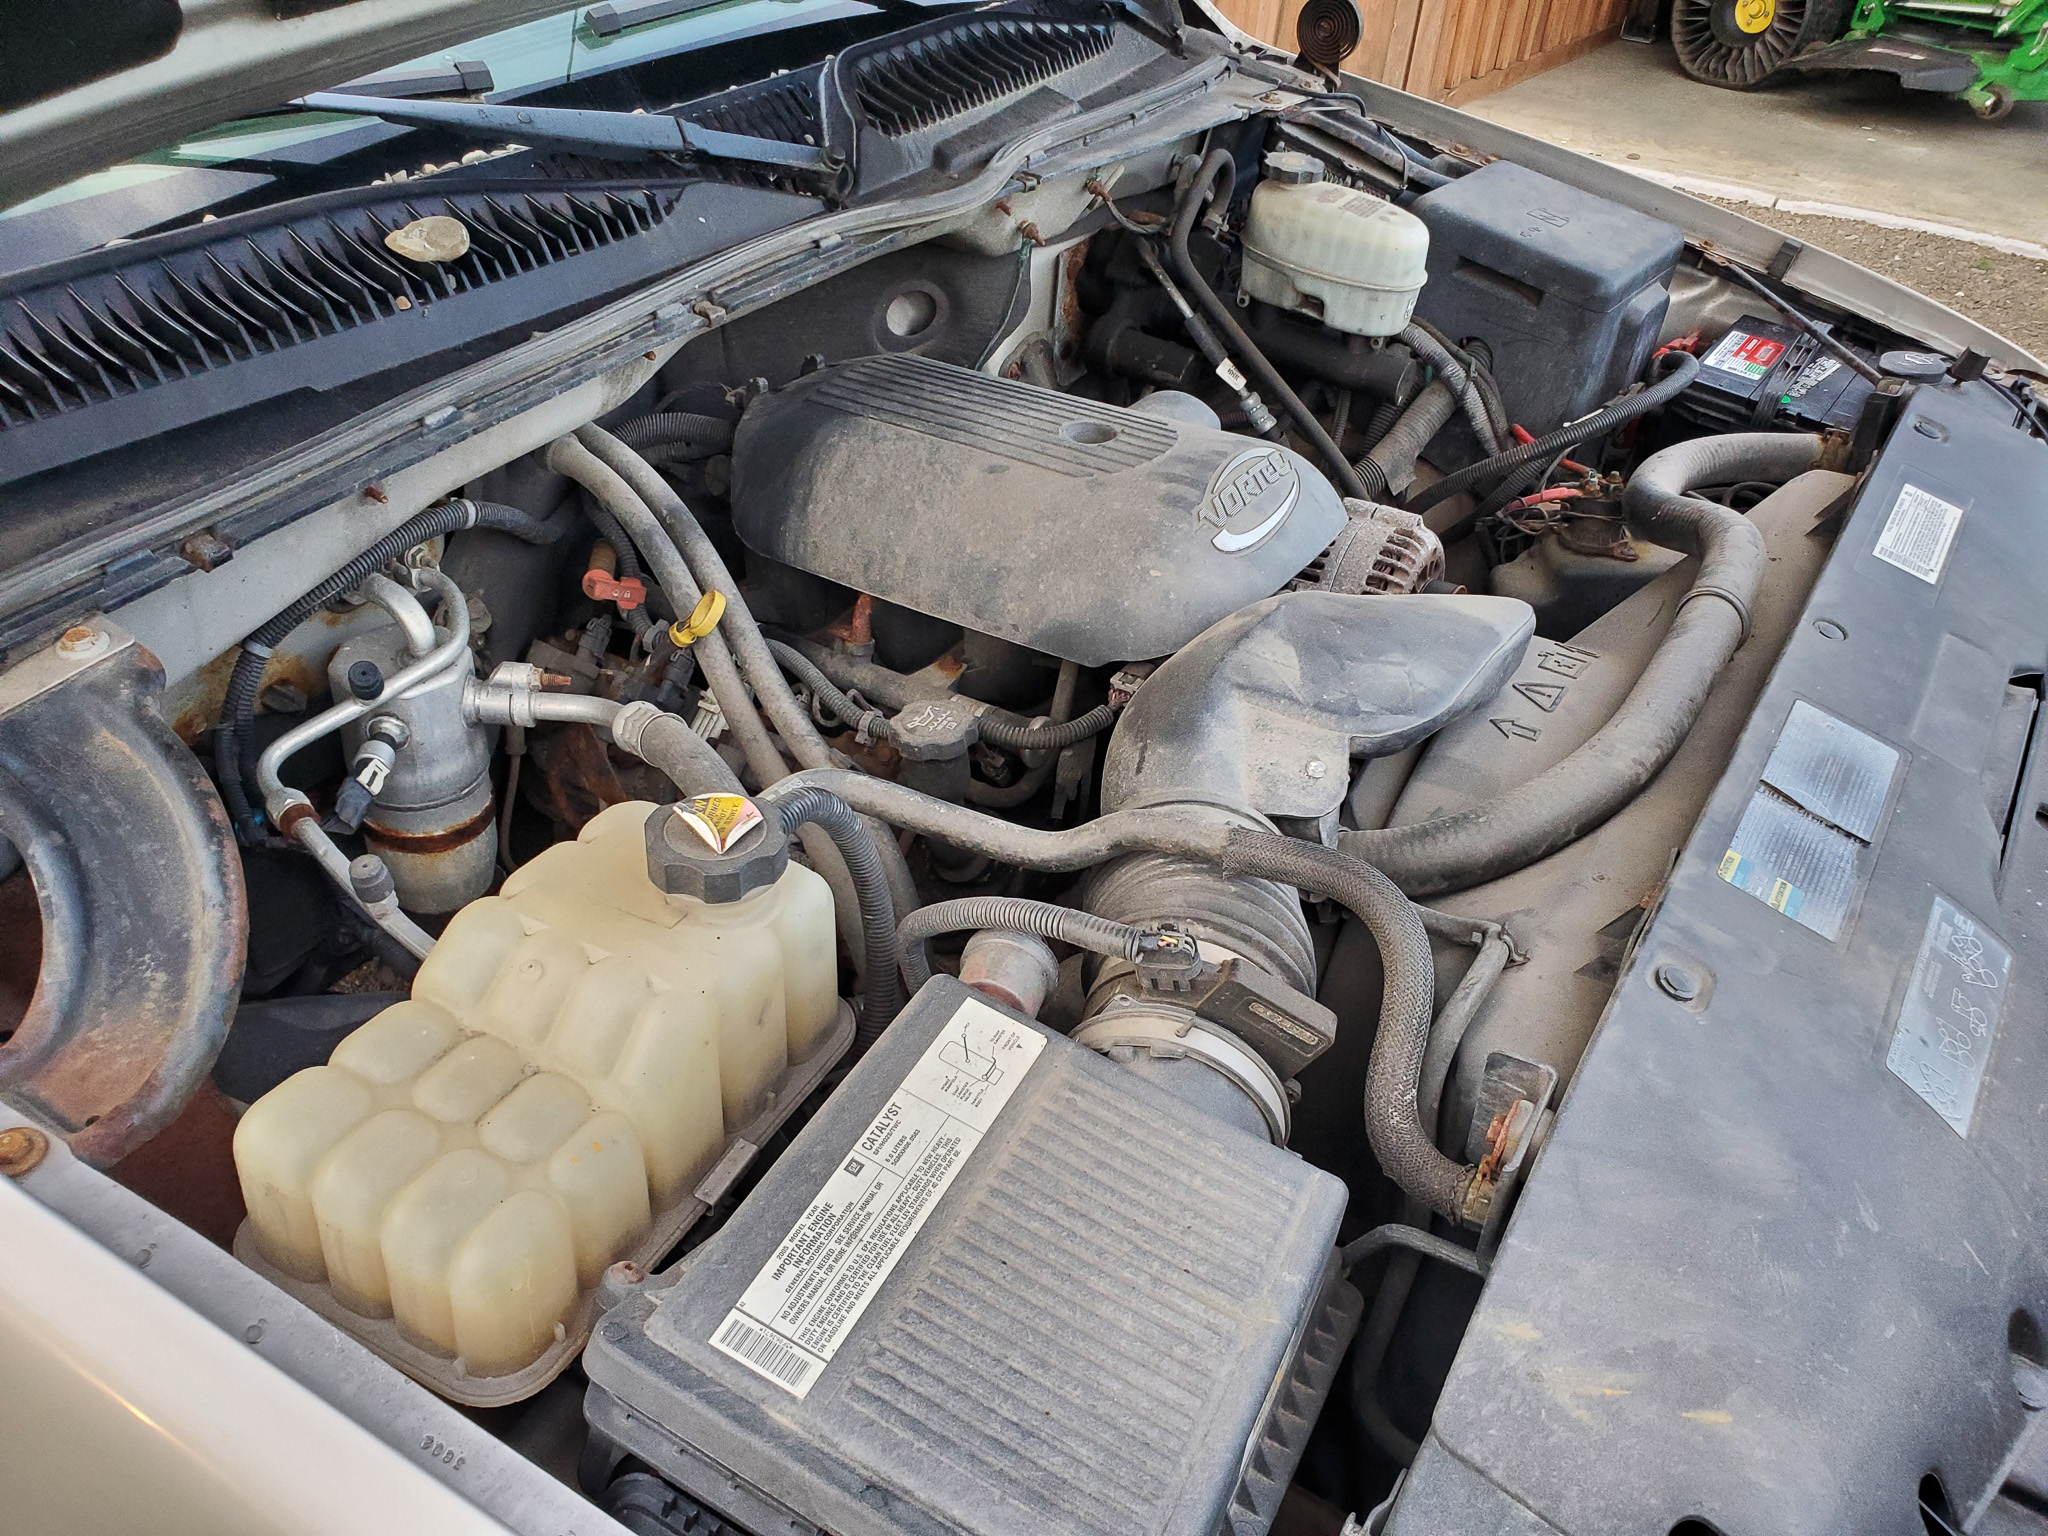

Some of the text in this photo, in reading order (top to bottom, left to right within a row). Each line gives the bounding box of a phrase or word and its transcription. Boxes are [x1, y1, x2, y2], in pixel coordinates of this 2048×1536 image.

[1198, 451, 1292, 528] VORTEC
[860, 1100, 902, 1151] CATALYST
[890, 1134, 908, 1154] LITERS
[930, 1180, 939, 1189] 40
[934, 1169, 946, 1182] CFR
[942, 1156, 955, 1171] PART
[775, 1203, 820, 1260] 2005 MODEL YEAR
[791, 1211, 837, 1269] INFORMATION
[896, 1196, 929, 1238] REQUIREMENTS
[770, 1200, 834, 1281] IMPORTANT ENGINE
[779, 1180, 884, 1321] NO ADJUSTMENTS NEEDED. SEE SERVICE MANUAL OR
[784, 1200, 854, 1294] GENERAL MOTORS CORPORATION
[796, 1325, 811, 1341] THIS
[807, 1303, 826, 1327] ENGINE
[822, 1271, 849, 1305] CONFORMS
[844, 1263, 855, 1273] TO
[851, 1252, 864, 1265] U.S.
[860, 1239, 873, 1252] EPA
[868, 1202, 898, 1241] REGULATIONS
[894, 1172, 920, 1204] APPLICABLE
[915, 1164, 925, 1173] TO
[921, 1151, 933, 1165] NEW
[803, 1327, 818, 1345] DUTY
[815, 1302, 837, 1329] ENGINES
[833, 1289, 846, 1303] AND
[842, 1282, 851, 1290] IS
[847, 1253, 871, 1283] CERTIFIED
[867, 1241, 879, 1254] FOR
[875, 1229, 888, 1242] USE
[883, 1222, 892, 1231] IN
[889, 1212, 900, 1224] ALL
[940, 1136, 953, 1149] THIS
[810, 1136, 961, 1349] ENGINE IS CERTIFIED TO THE CLEAN FUEL FLEET LEV STANDARDS WHEN OPERATED
[874, 1236, 901, 1271] APPLICABLE
[787, 1210, 875, 1325] OWNERS MANUAL FOR MORE INFORMATION.
[852, 1280, 870, 1301] MEETS
[866, 1269, 878, 1282] ALL
[823, 1313, 847, 1343] GASOLINE
[843, 1299, 856, 1315] AND
[816, 1342, 827, 1353] ON
